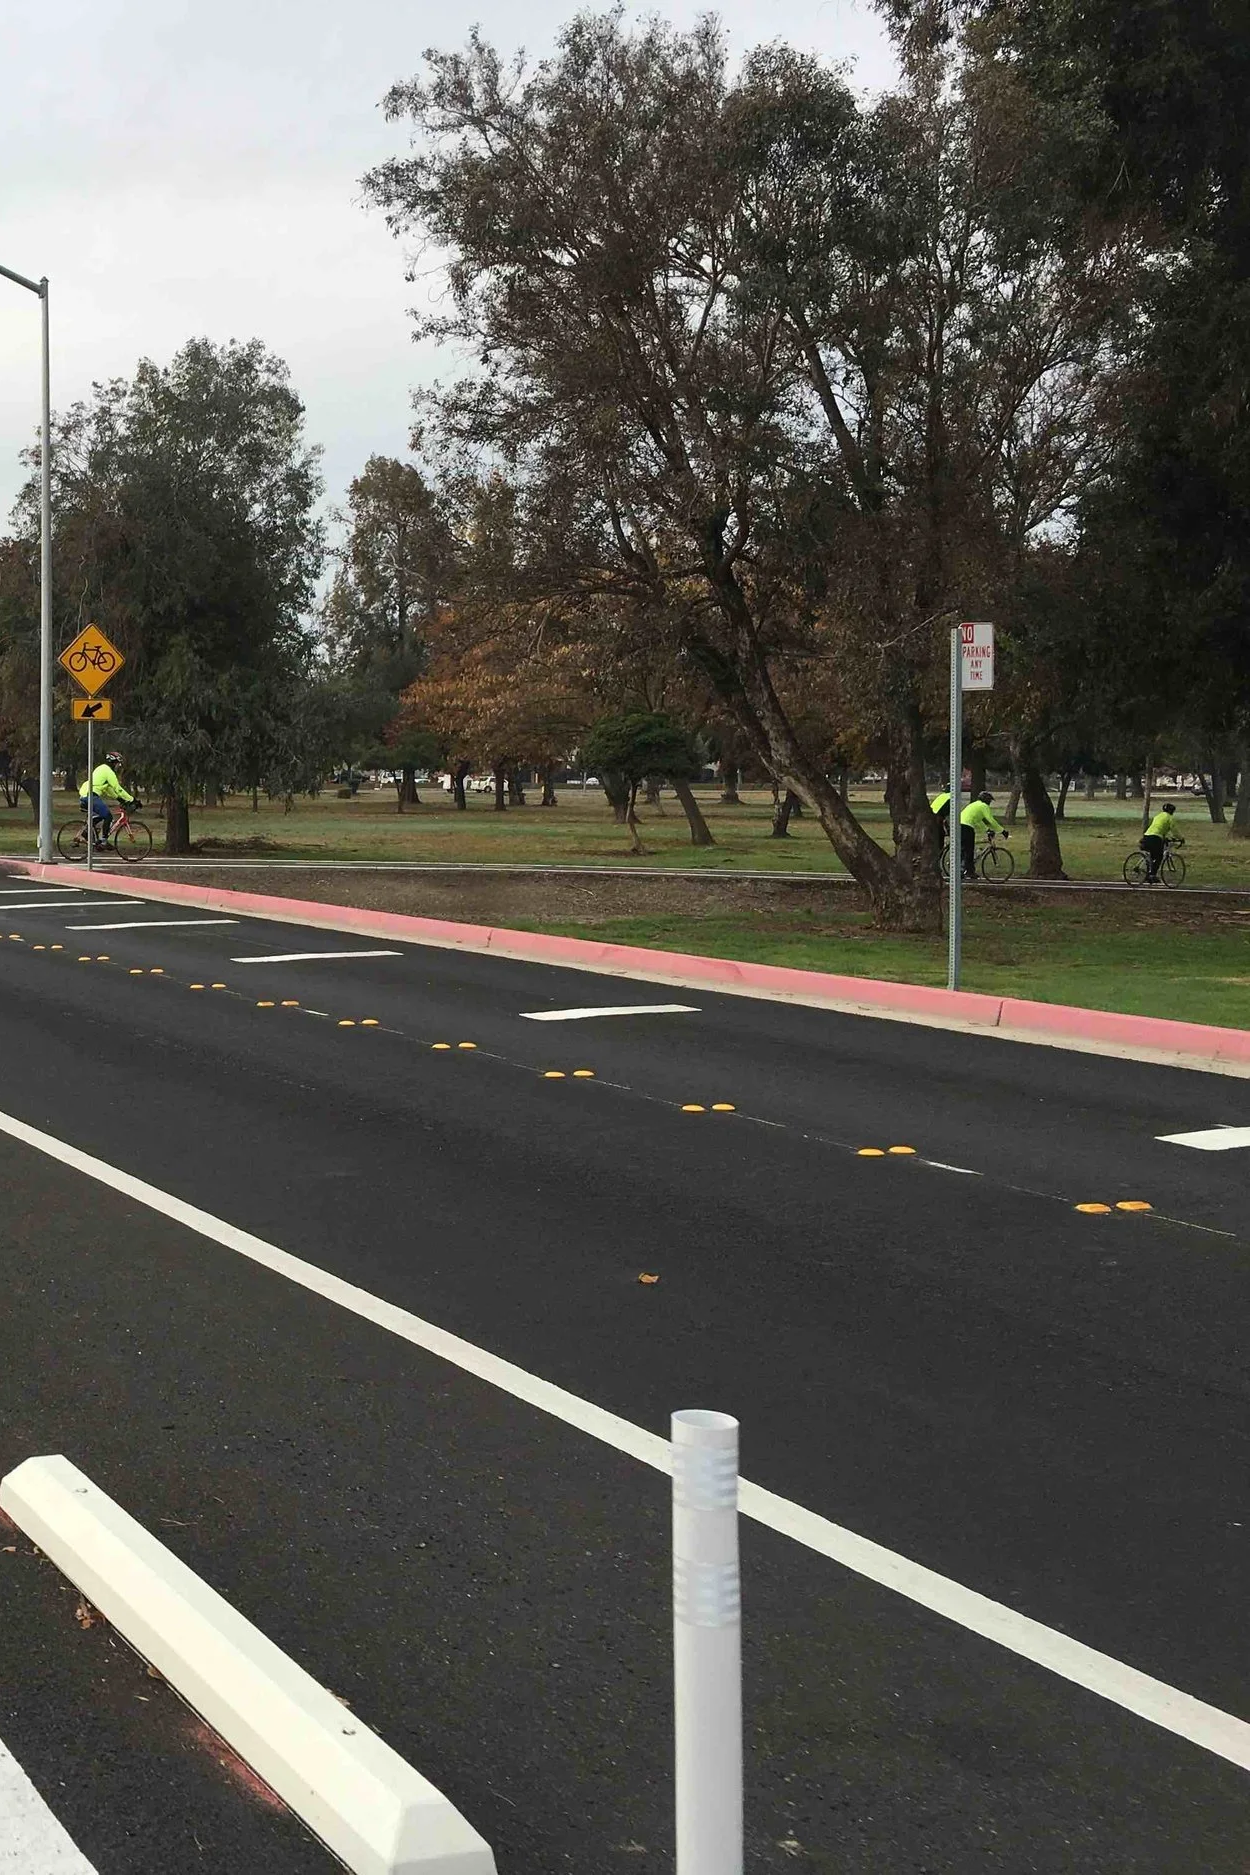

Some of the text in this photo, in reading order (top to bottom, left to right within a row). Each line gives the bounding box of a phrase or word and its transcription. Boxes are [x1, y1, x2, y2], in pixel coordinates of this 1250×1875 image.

[963, 646, 991, 658] PARKING
[971, 660, 982, 668] ANY
[970, 671, 983, 680] TIME
